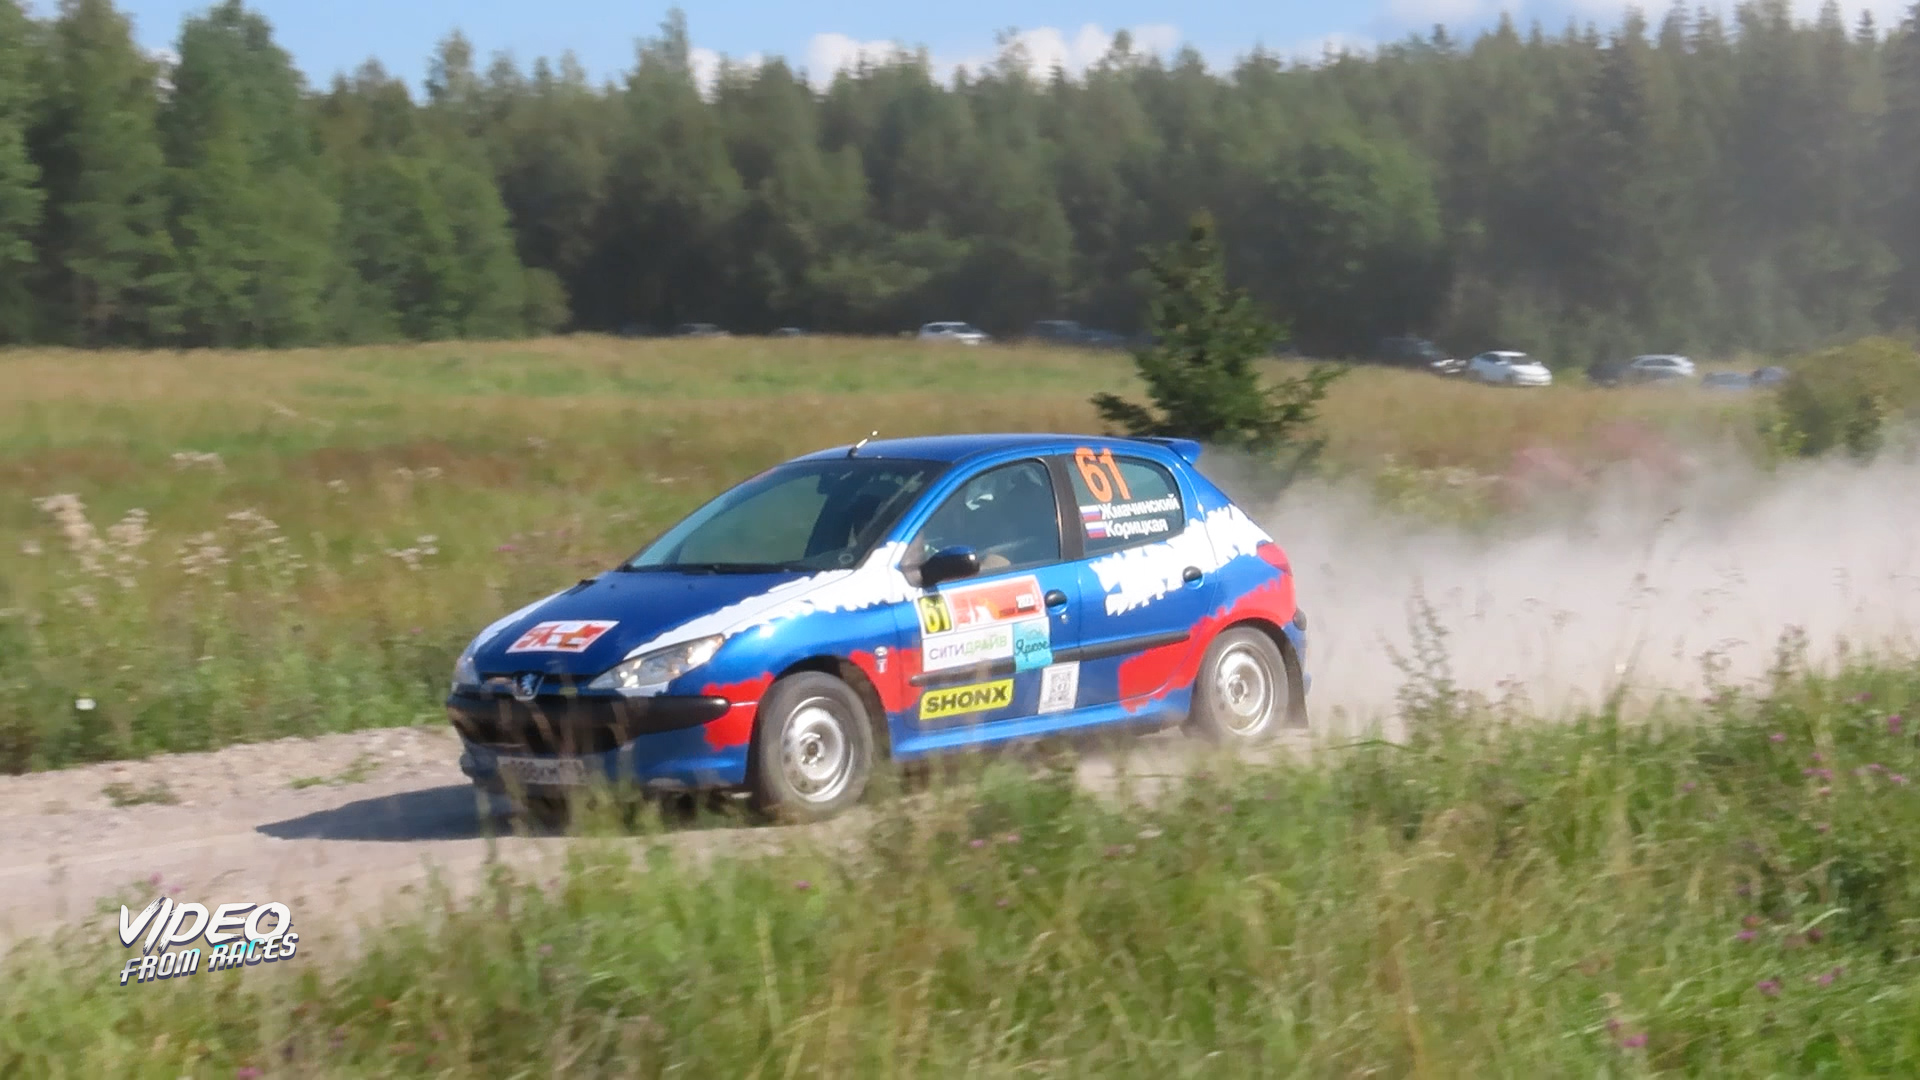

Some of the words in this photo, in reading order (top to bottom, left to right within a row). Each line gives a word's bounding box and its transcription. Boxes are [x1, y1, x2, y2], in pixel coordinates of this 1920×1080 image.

[1074, 446, 1131, 502] 61
[1099, 493, 1180, 520] Жмачинский
[1104, 518, 1169, 539] Корицкая
[921, 595, 951, 633] 61
[929, 634, 1008, 660] СИТИДРАЙВ
[926, 685, 1009, 713] SHONX
